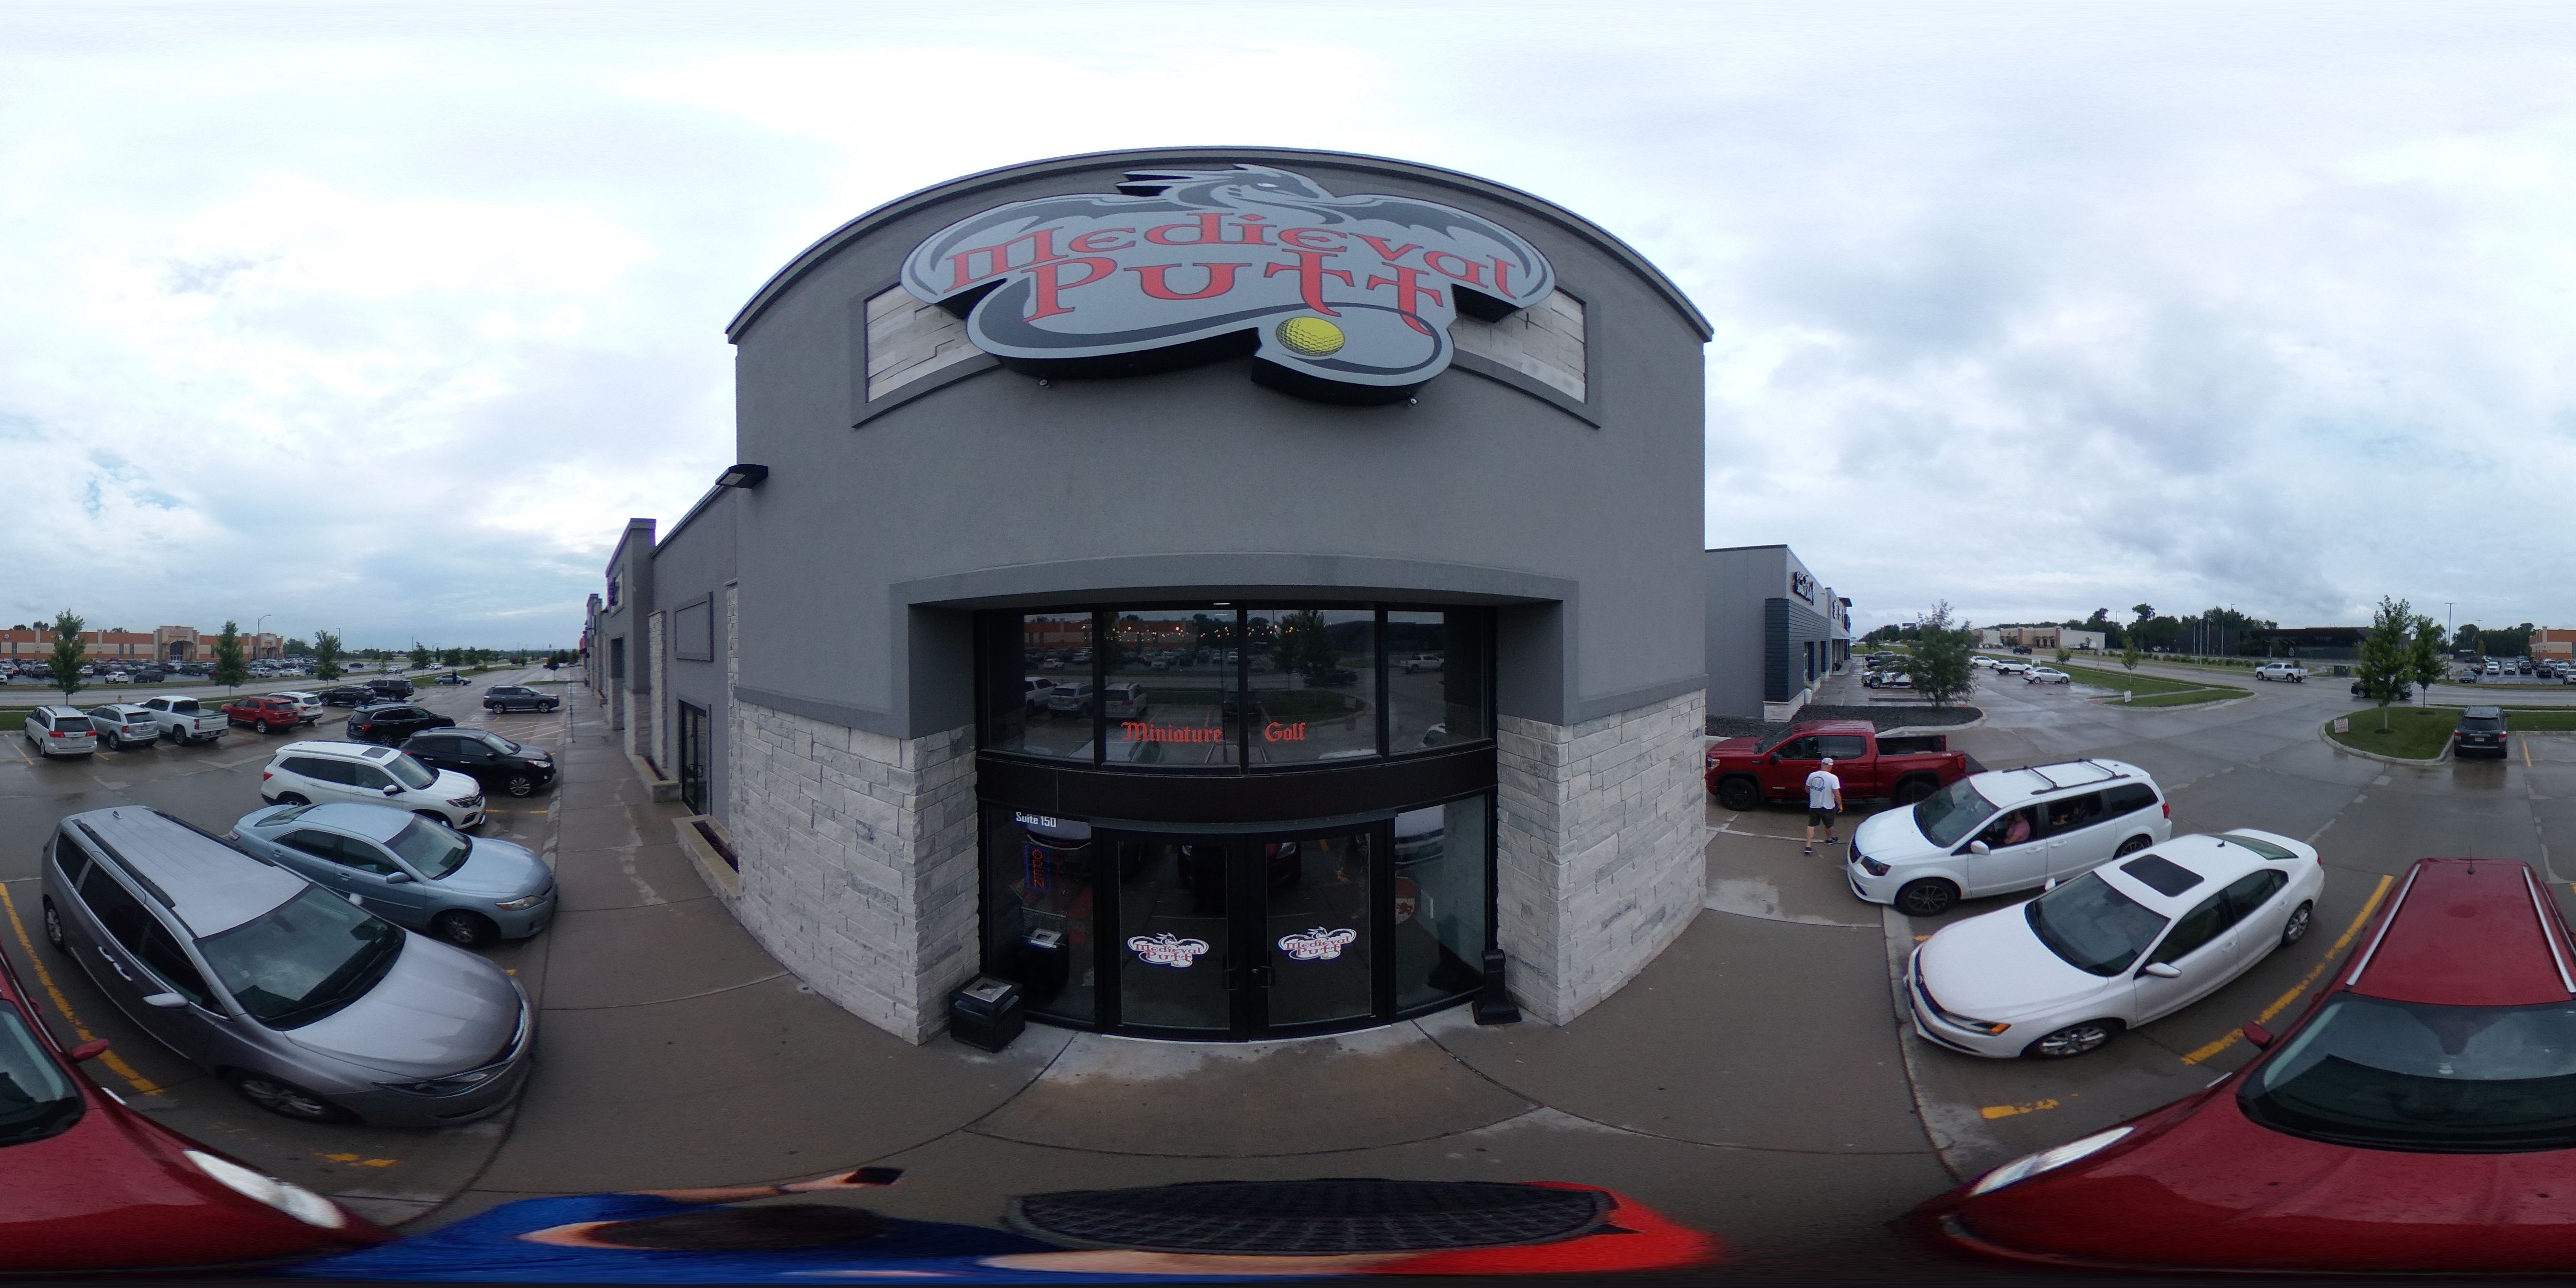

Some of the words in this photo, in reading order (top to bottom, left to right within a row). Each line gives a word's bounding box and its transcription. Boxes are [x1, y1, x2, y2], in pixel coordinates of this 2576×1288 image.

[944, 212, 1518, 299] Medieval
[1024, 247, 1444, 336] Putt
[1121, 722, 1223, 743] Miniature
[1265, 722, 1306, 742] Golf
[1016, 811, 1038, 824] Suite
[1041, 816, 1057, 828] 150
[1136, 944, 1201, 954] Medieval
[1287, 936, 1350, 949] Medieval
[1297, 944, 1340, 955] Putt
[1146, 951, 1192, 961] Putt
